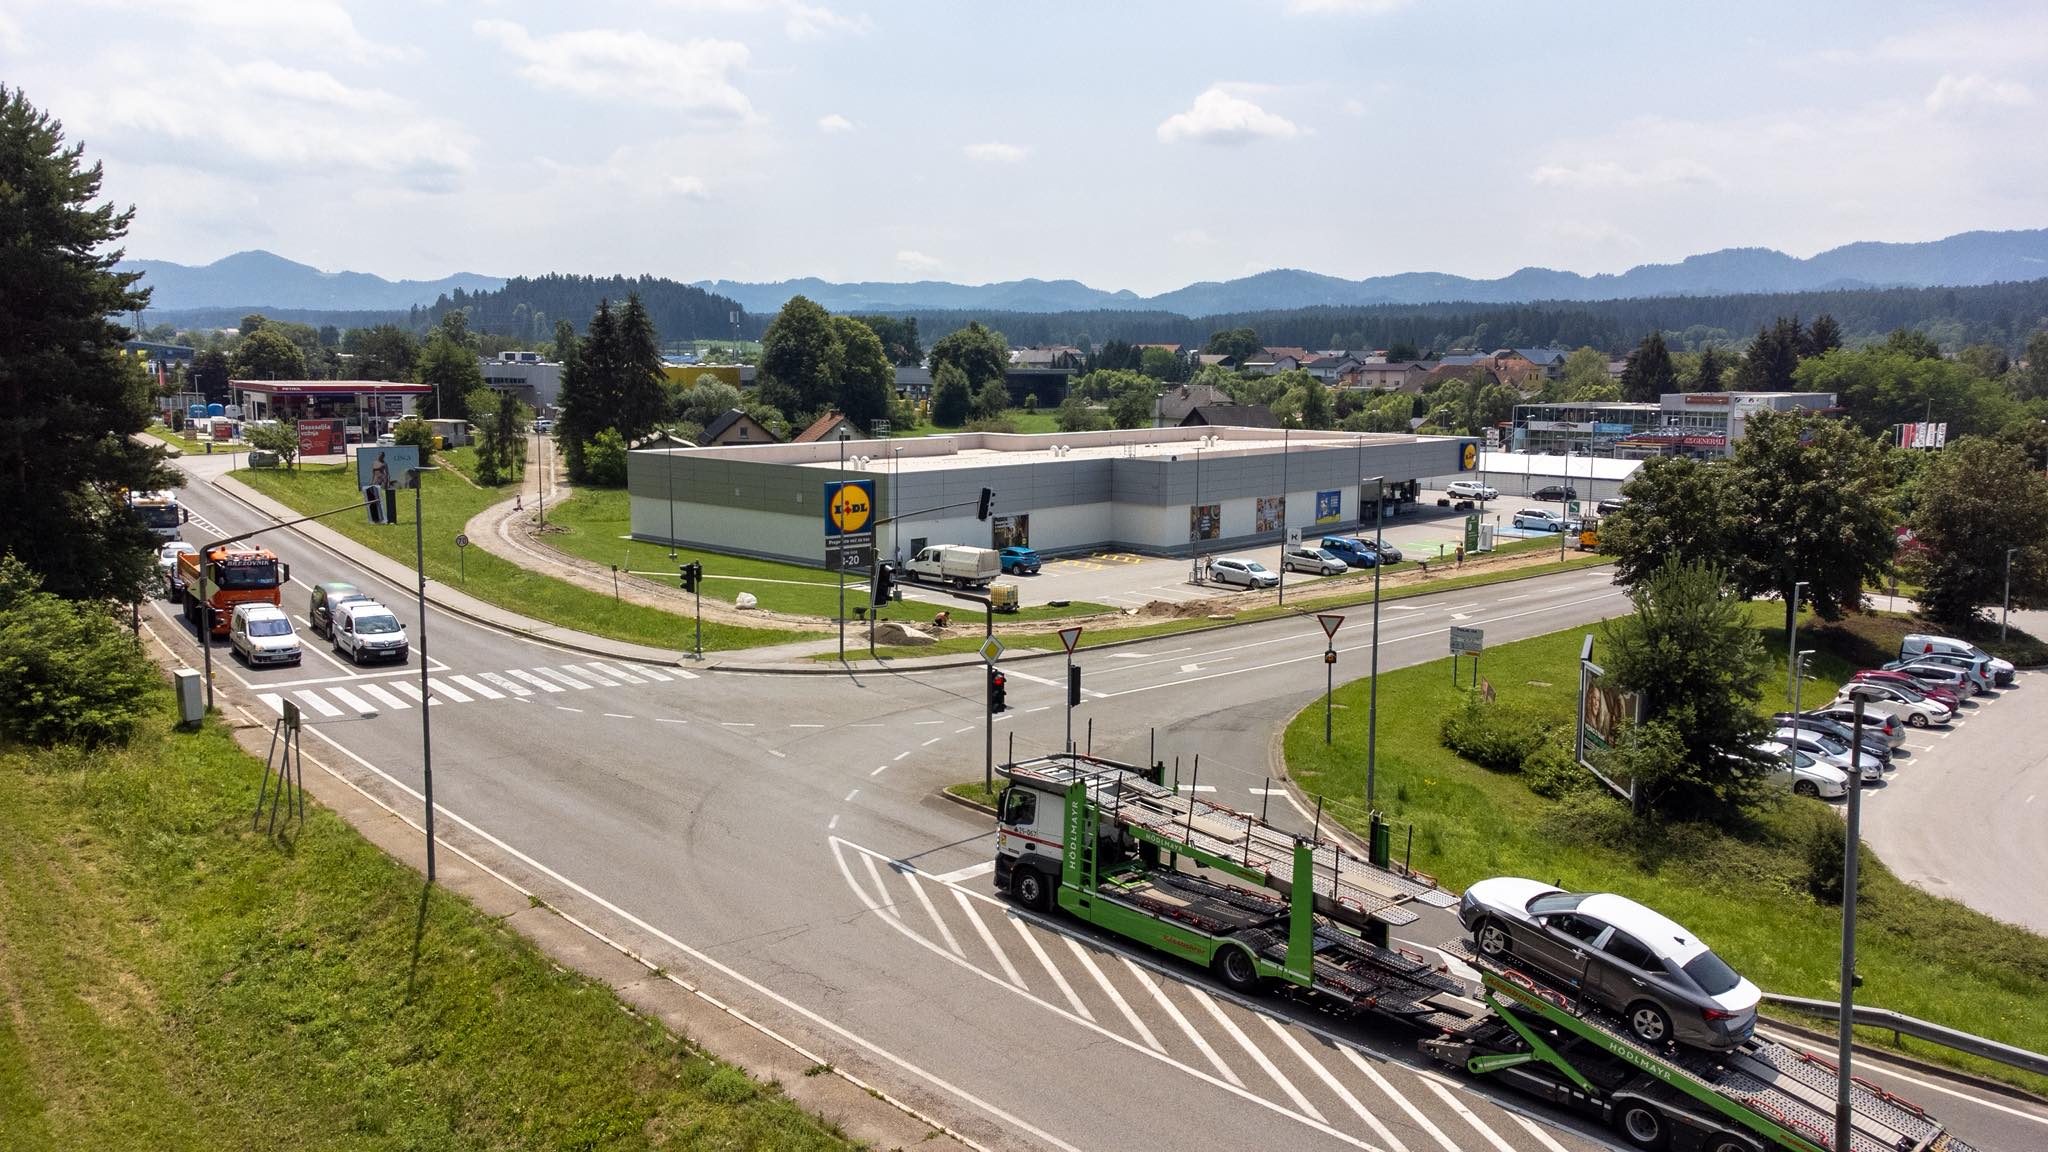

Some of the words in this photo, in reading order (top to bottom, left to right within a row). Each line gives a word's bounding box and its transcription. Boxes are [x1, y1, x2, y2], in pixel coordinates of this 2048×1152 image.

[1693, 437, 1725, 445] GENERALI
[834, 500, 868, 515] LIDL
[458, 537, 467, 545] 70
